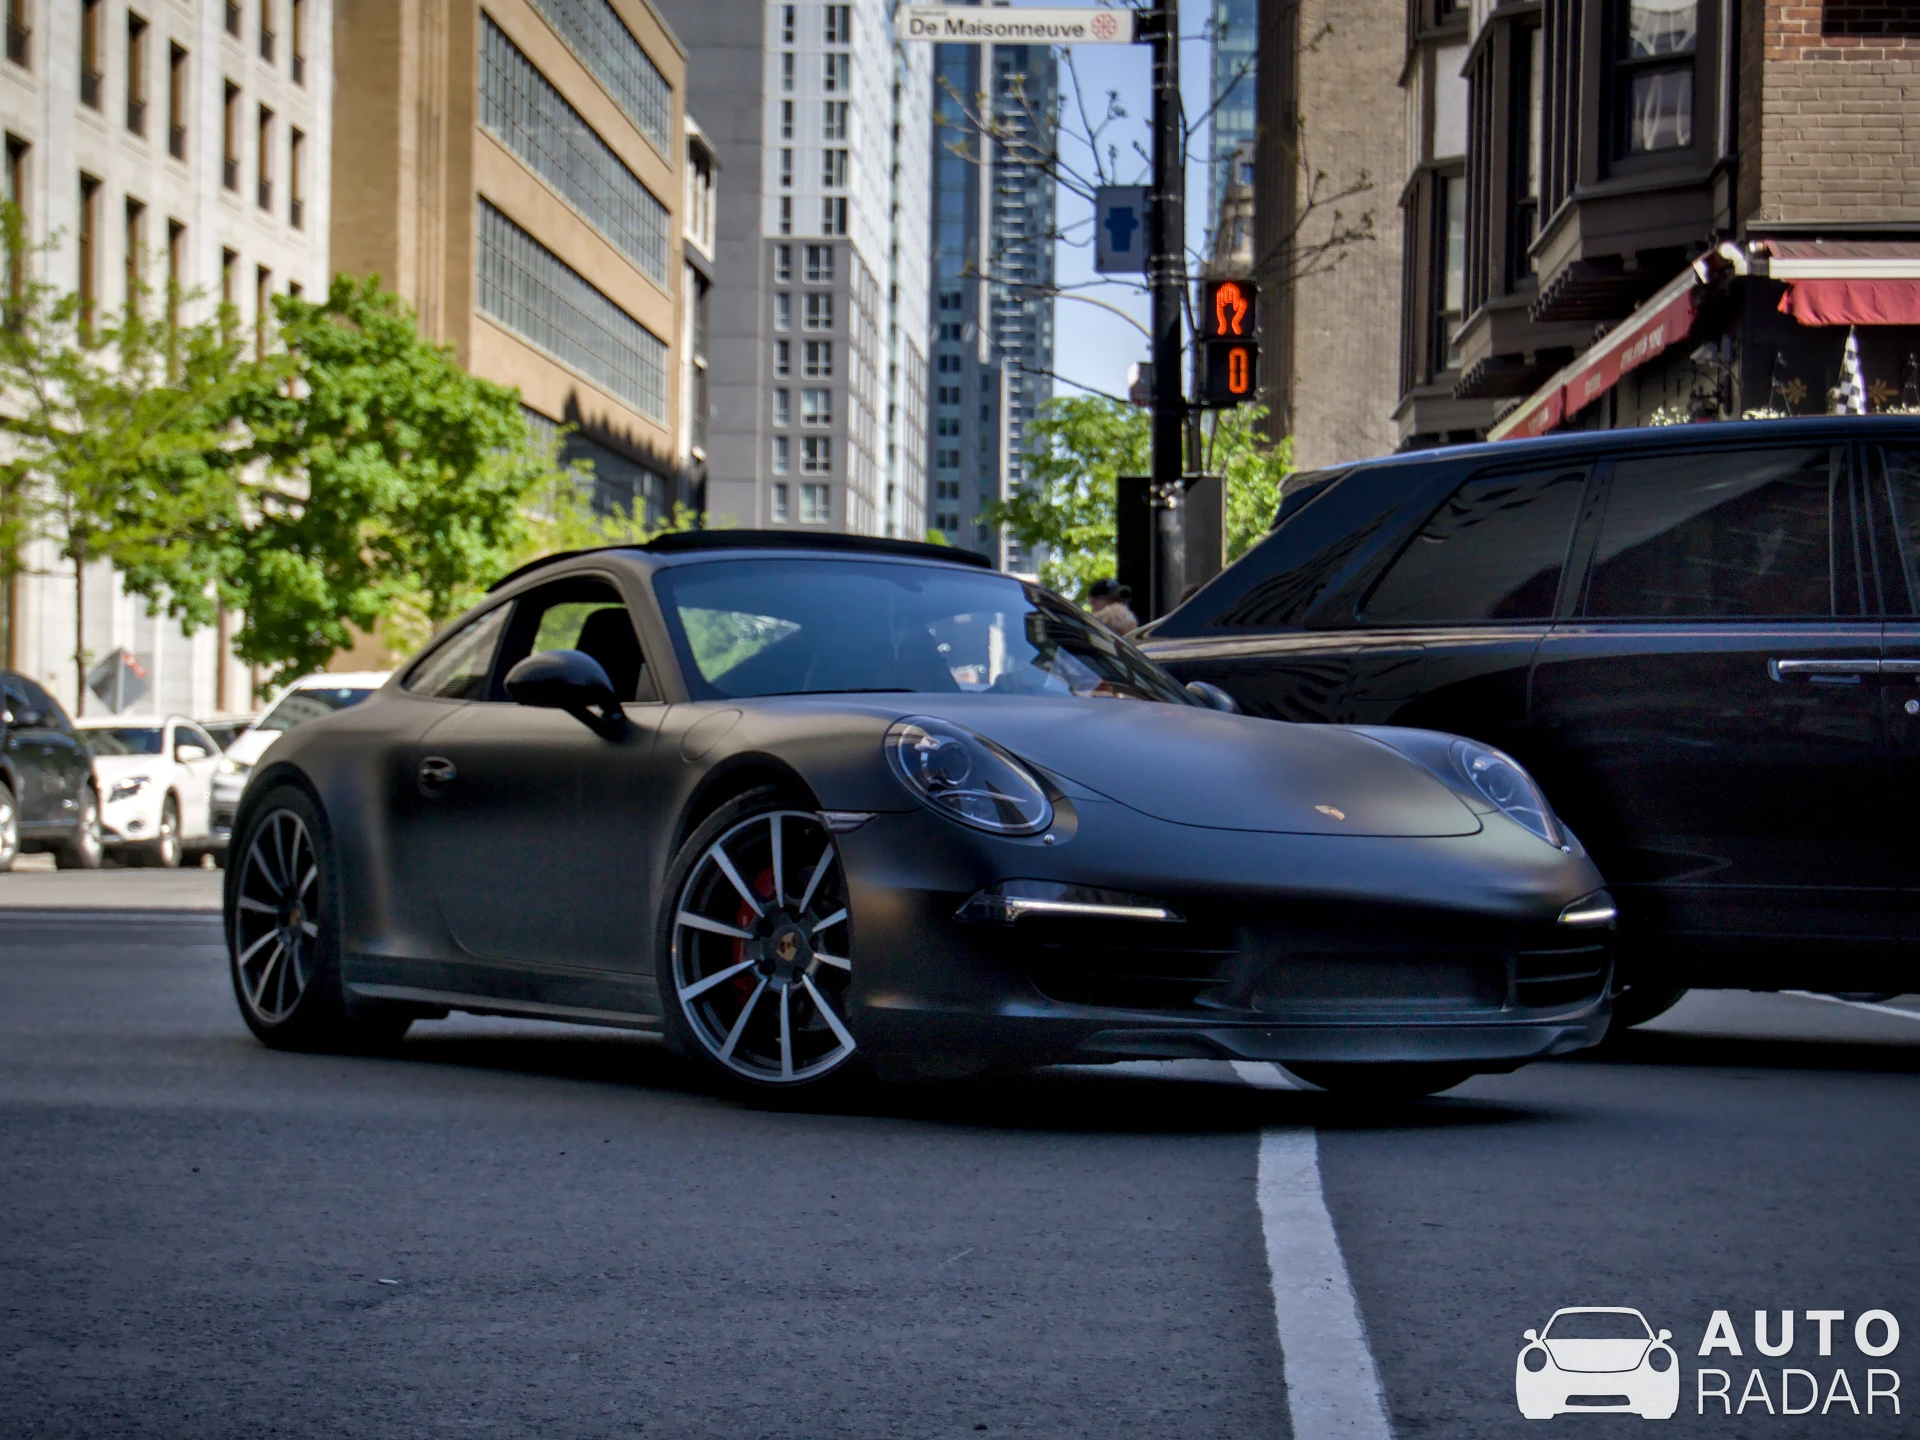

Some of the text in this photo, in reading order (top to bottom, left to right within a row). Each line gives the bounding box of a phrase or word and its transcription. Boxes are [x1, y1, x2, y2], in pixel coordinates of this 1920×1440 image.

[910, 19, 1085, 37] De Maisonneuve
[1229, 348, 1248, 393] 0
